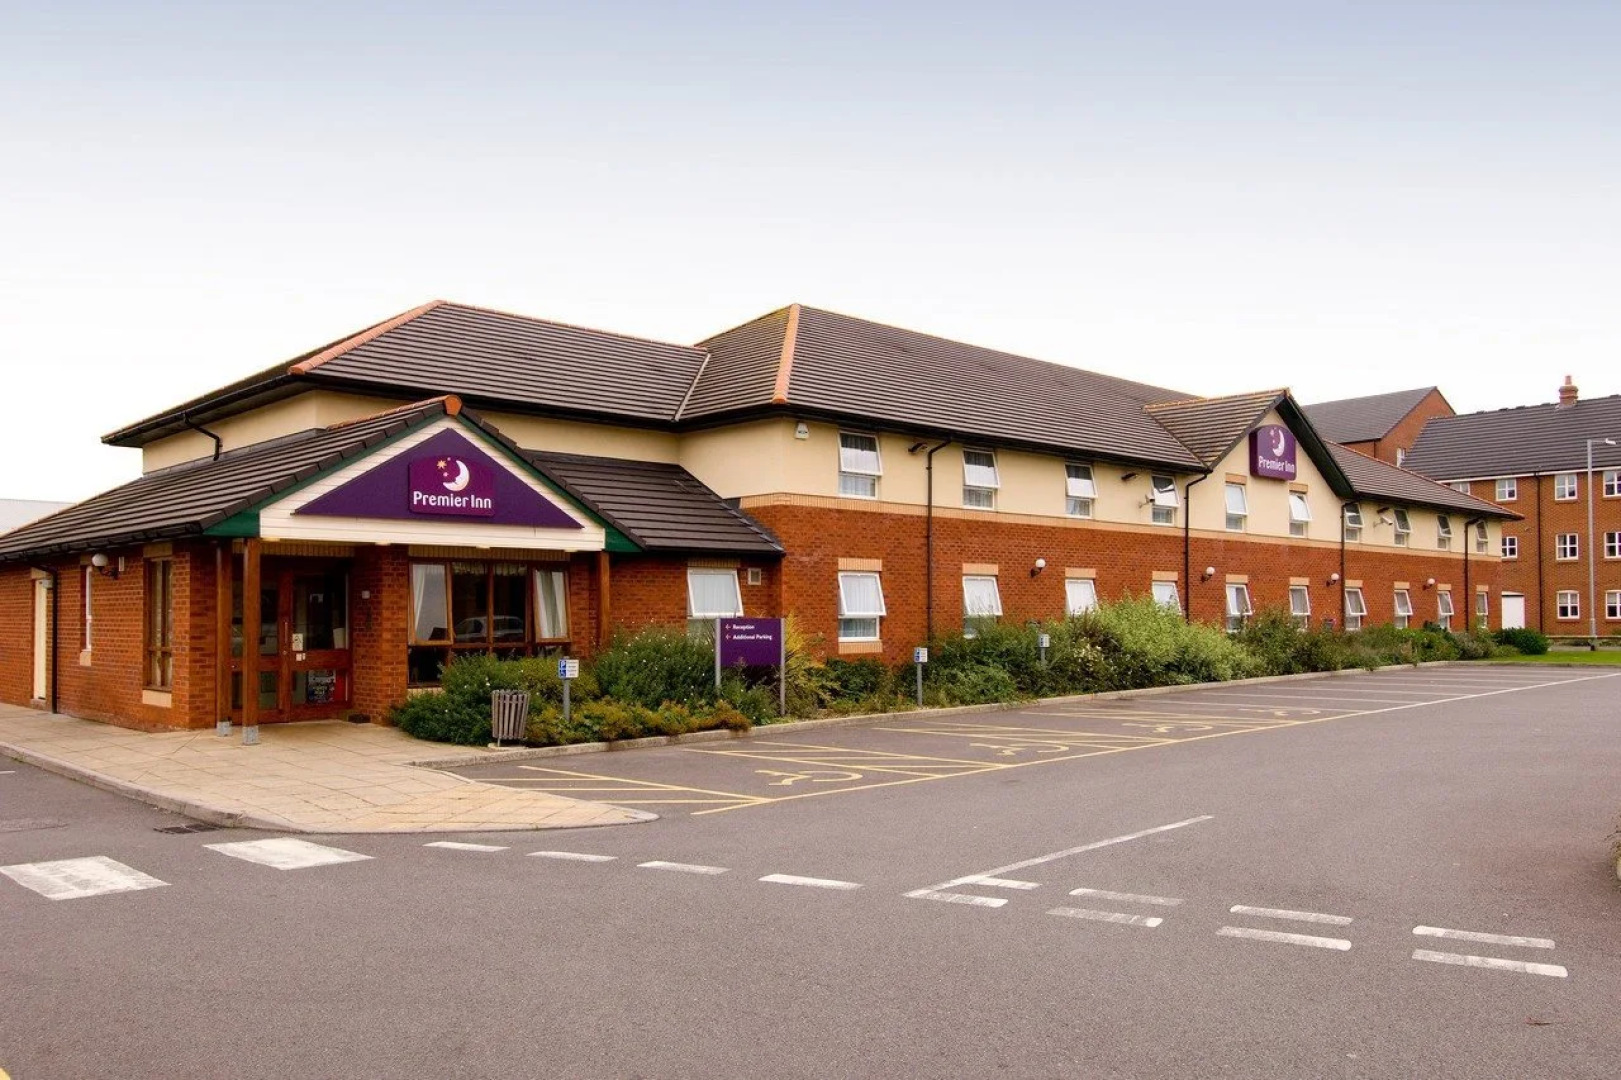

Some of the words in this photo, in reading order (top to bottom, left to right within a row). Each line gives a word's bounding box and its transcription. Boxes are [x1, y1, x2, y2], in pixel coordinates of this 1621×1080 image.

[1258, 456, 1284, 471] Premier
[1285, 461, 1295, 473] Inn
[413, 491, 469, 507] Premier
[470, 495, 492, 509] Inn
